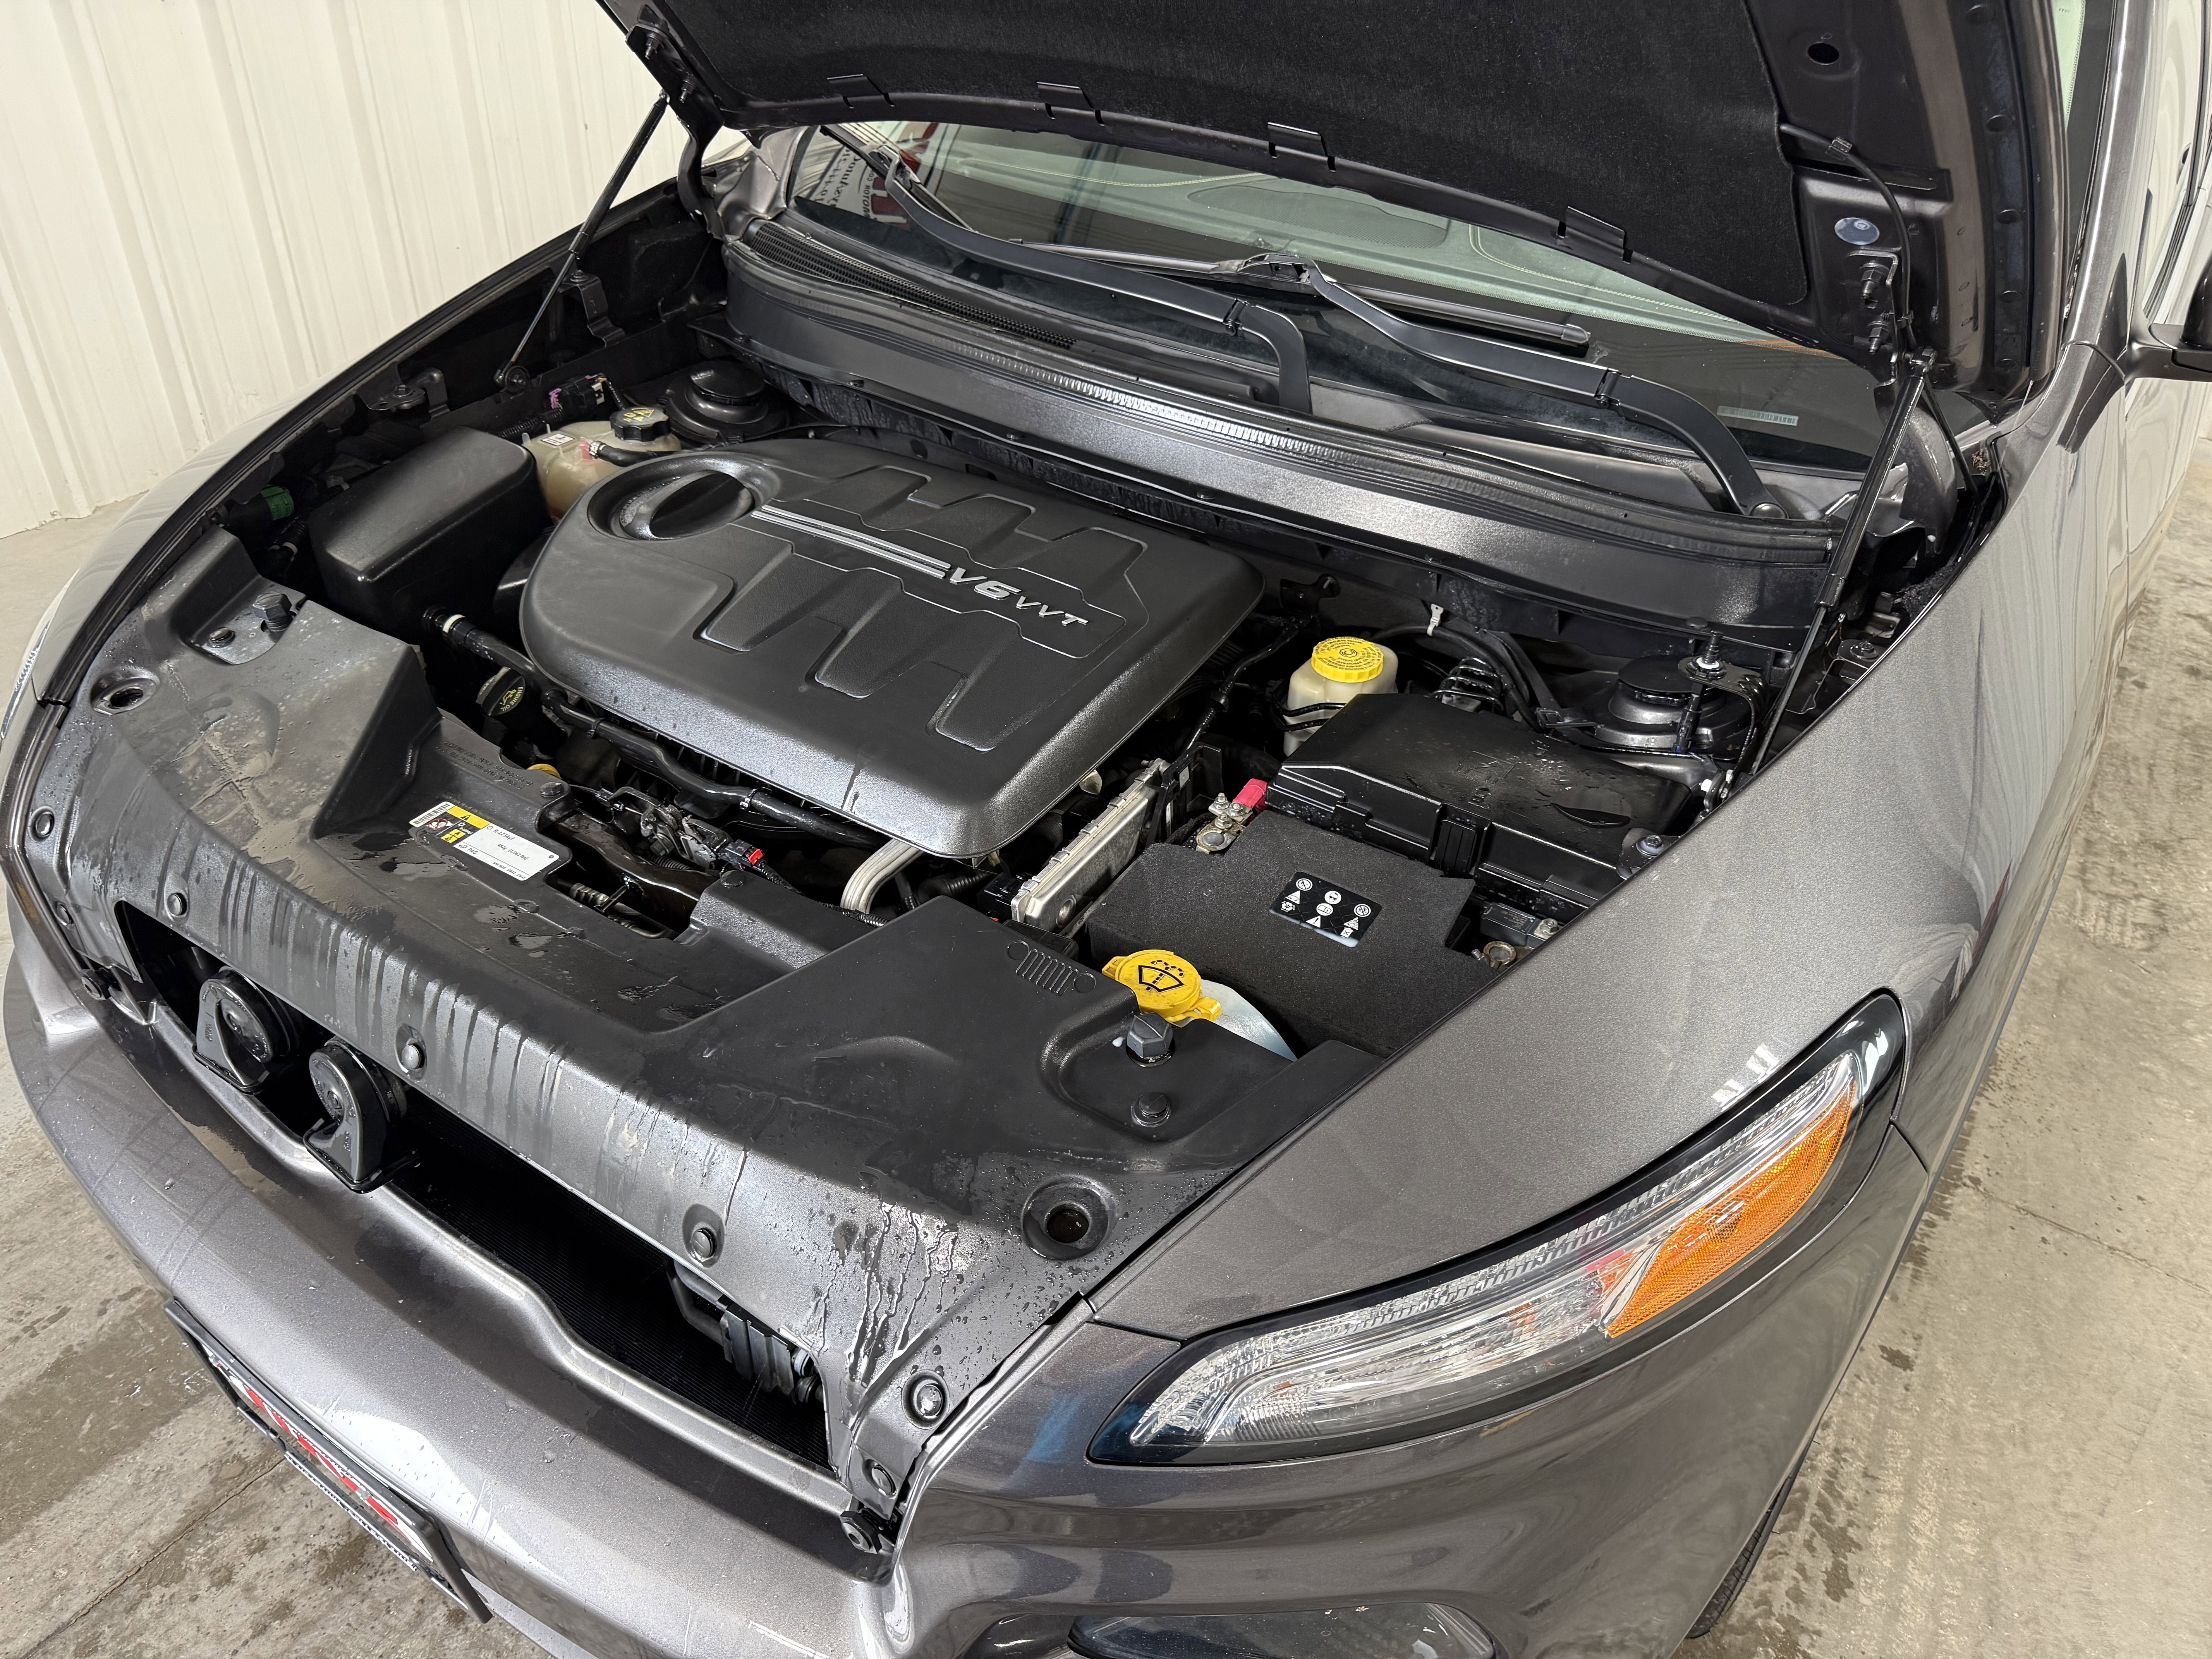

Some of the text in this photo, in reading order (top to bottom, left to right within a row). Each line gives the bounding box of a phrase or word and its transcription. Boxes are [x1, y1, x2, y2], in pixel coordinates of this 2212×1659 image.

[949, 567, 1089, 627] V6 VVT
[510, 687, 523, 705] ENGINE
[493, 829, 515, 840] R-1234yf
